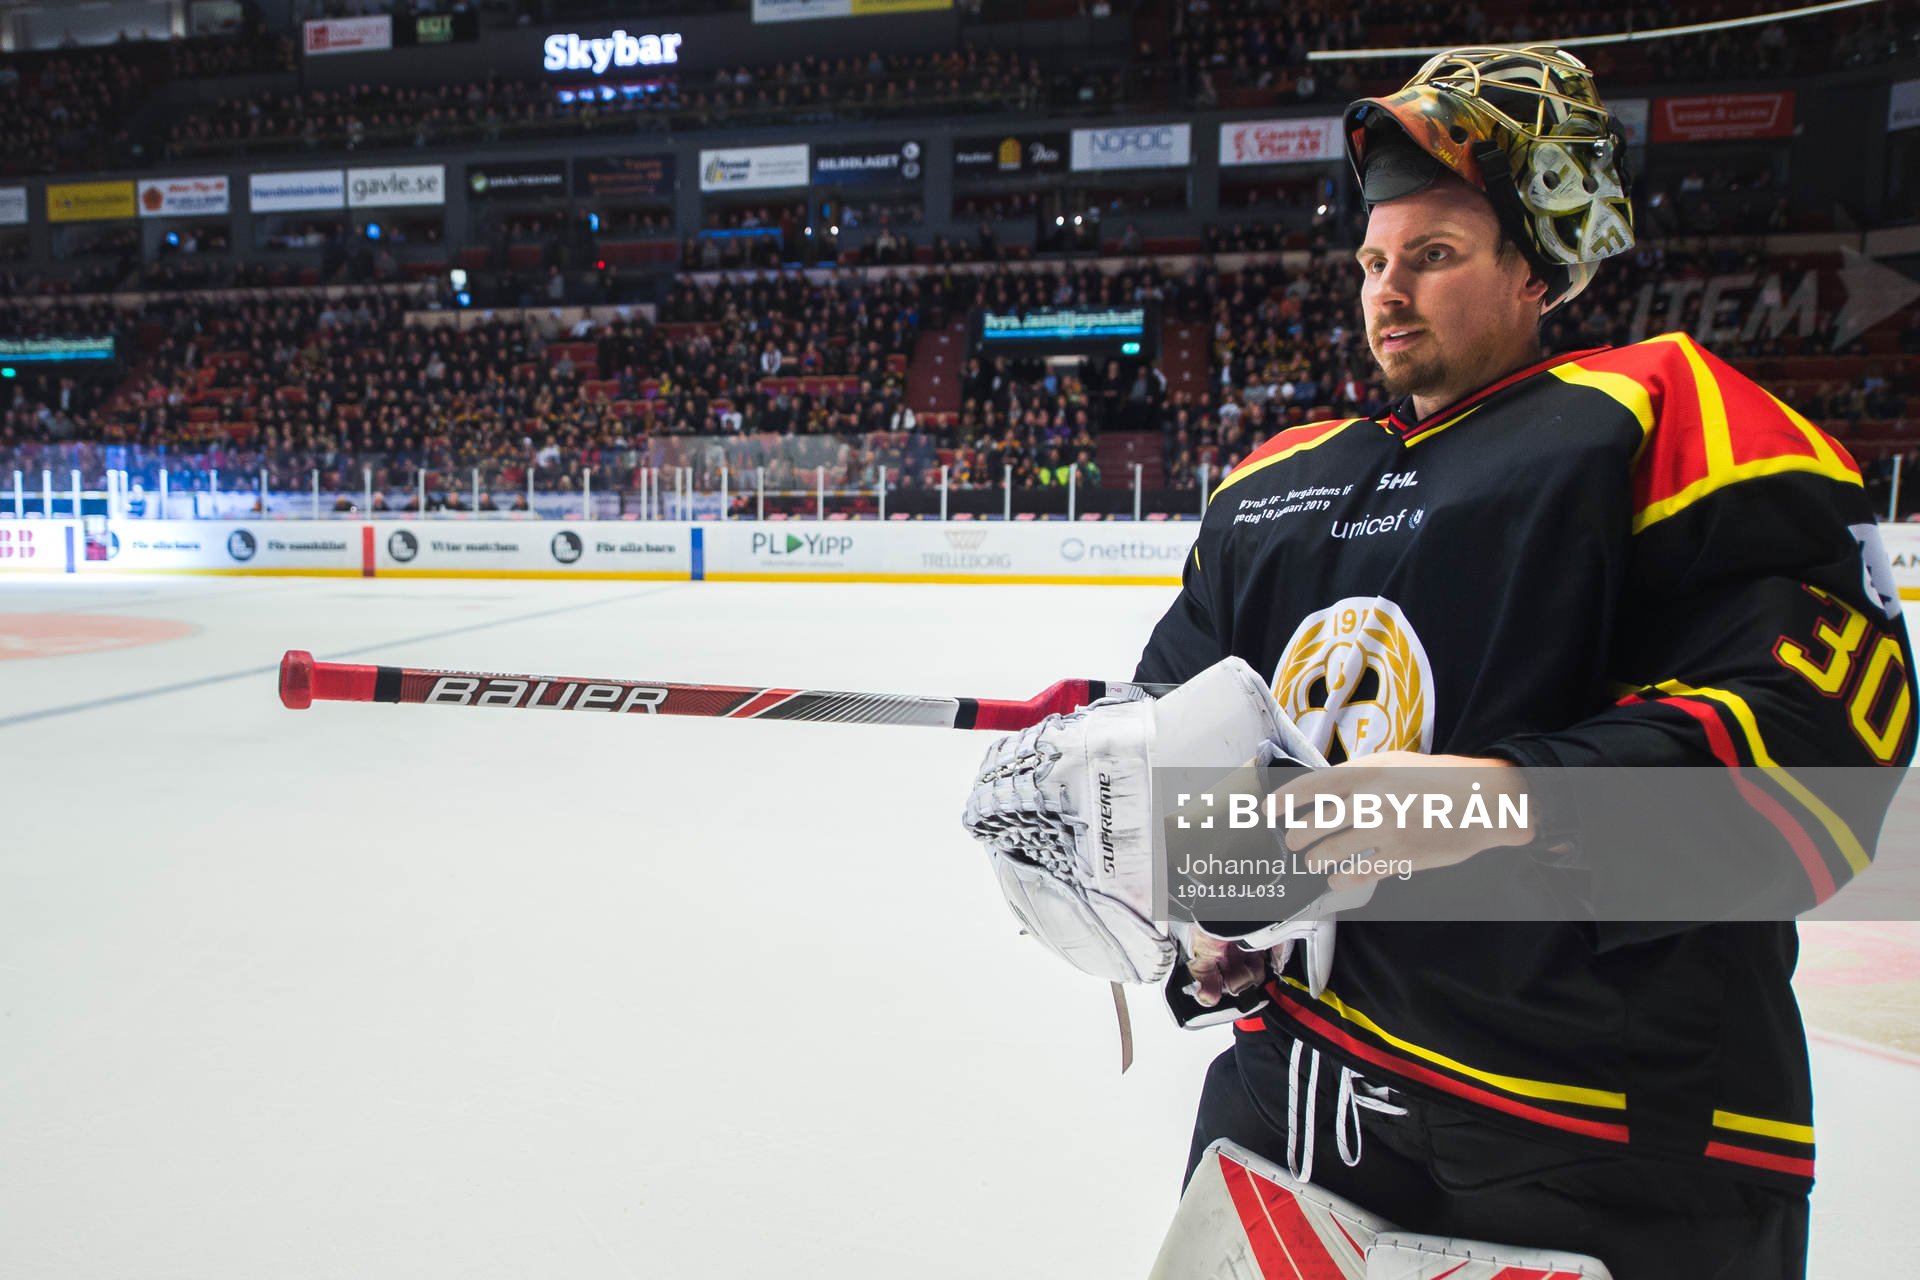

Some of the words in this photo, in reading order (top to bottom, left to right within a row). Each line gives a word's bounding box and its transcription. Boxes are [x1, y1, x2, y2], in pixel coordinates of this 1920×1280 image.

[544, 30, 682, 74] Skybar
[1342, 484, 1354, 496] IF
[1376, 471, 1419, 492] SHL
[1262, 509, 1275, 519] 18
[1303, 500, 1331, 511] 2019
[1331, 509, 1408, 539] unicef
[596, 541, 616, 552] För
[620, 541, 642, 552] alla
[922, 552, 1012, 568] TRELLEBORG
[1099, 772, 1115, 879] SUPREME
